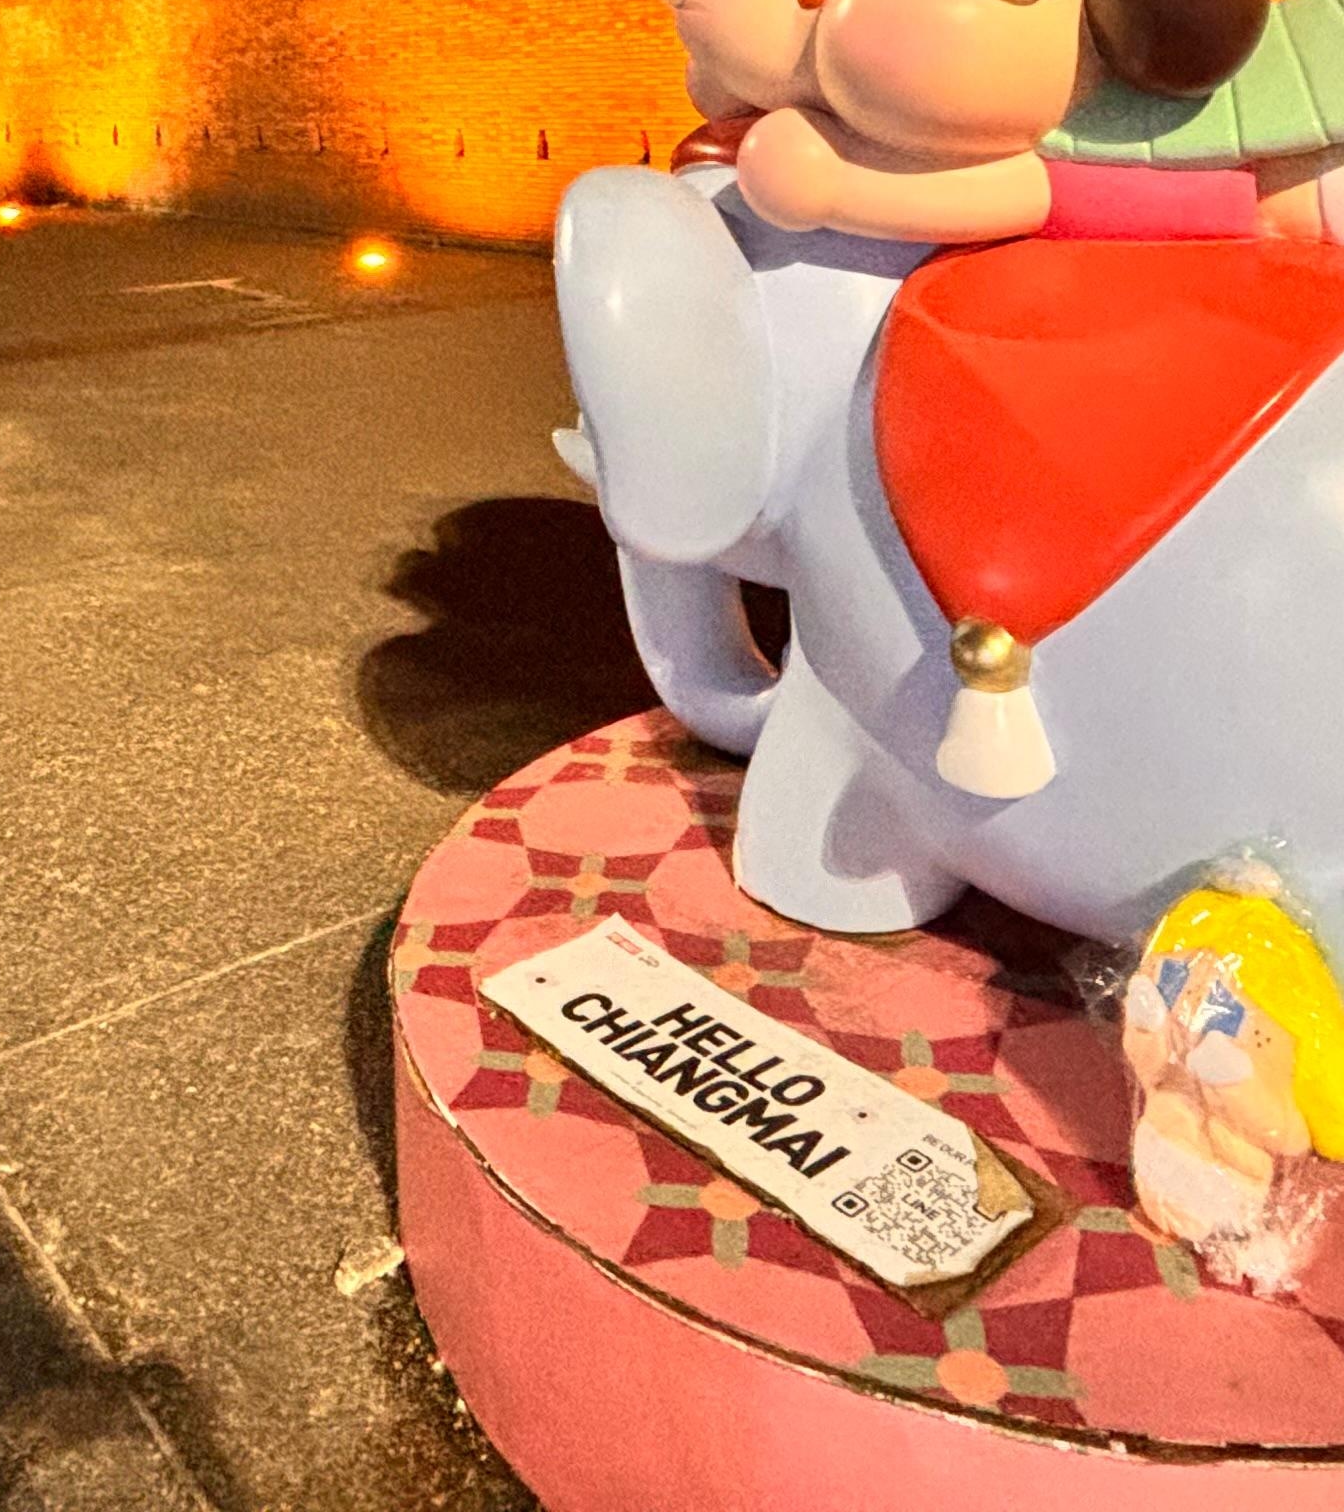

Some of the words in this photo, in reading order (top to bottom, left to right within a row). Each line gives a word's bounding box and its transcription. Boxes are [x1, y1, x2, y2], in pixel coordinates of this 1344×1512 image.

[561, 993, 852, 1179] CHIANGMAI
[651, 1002, 826, 1107] HELLO
[901, 1192, 941, 1221] LINE
